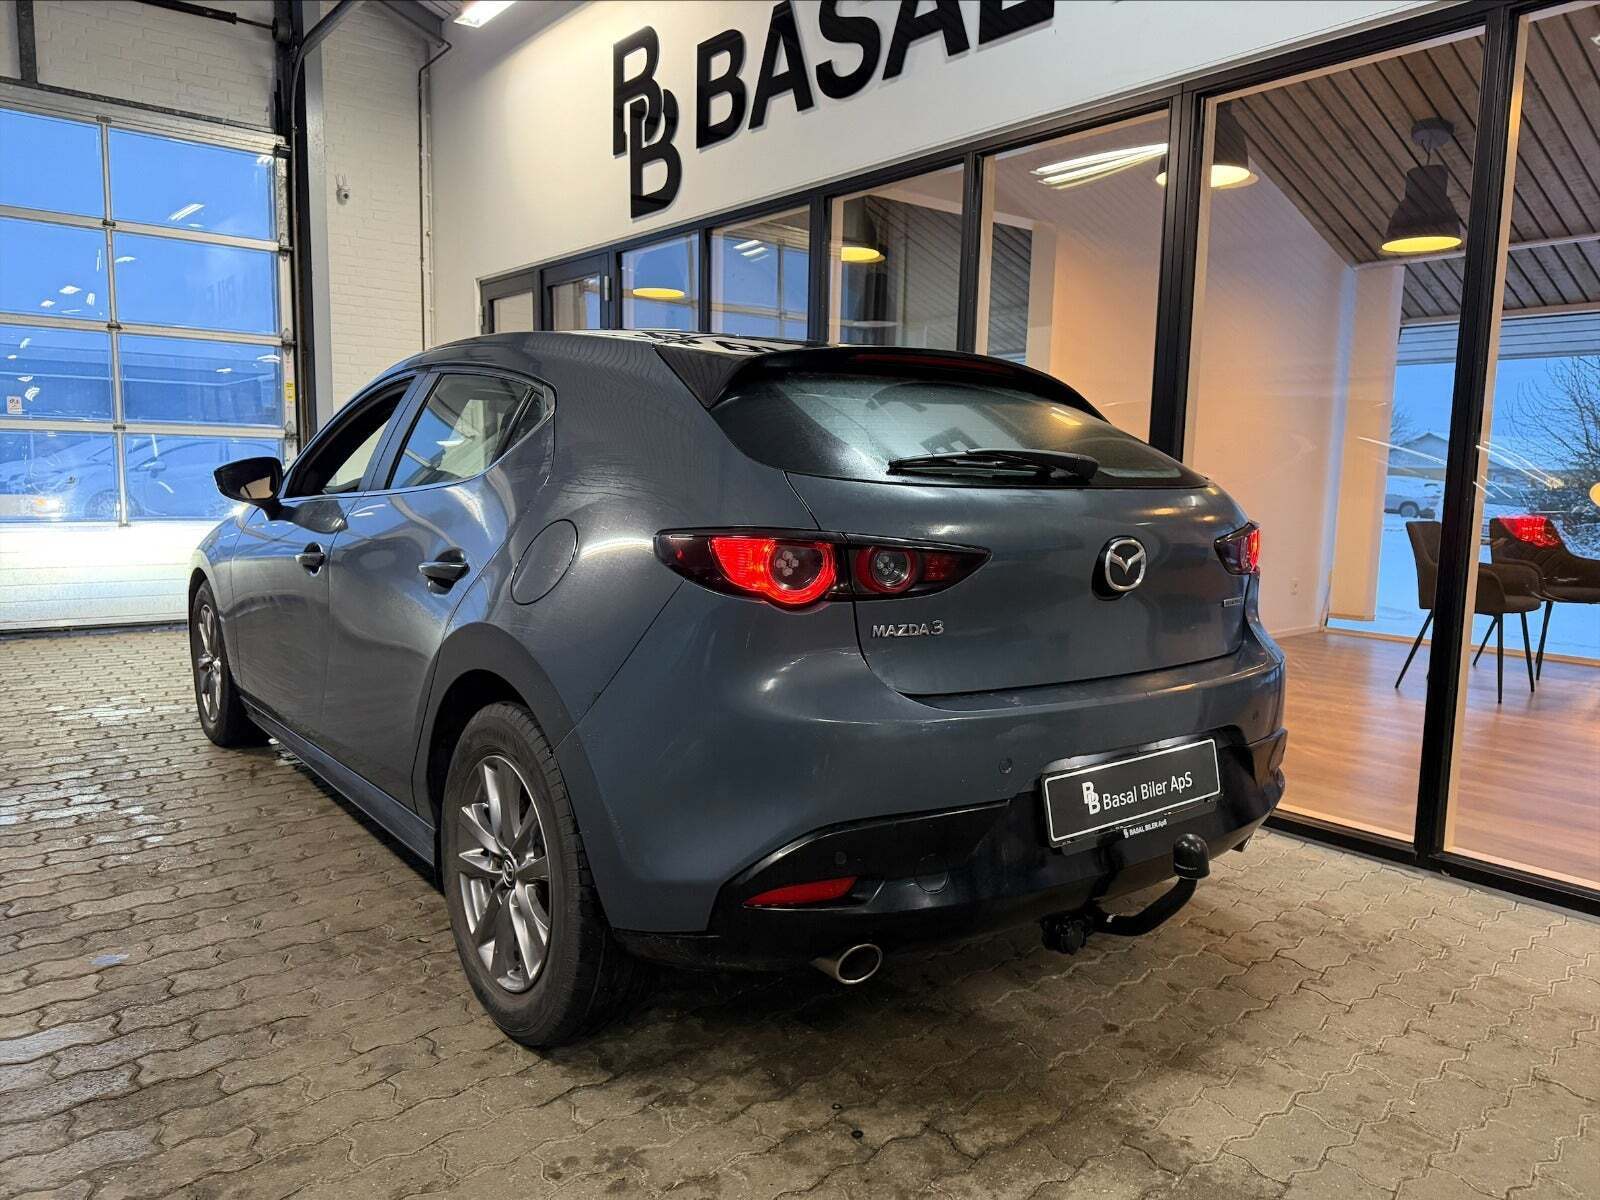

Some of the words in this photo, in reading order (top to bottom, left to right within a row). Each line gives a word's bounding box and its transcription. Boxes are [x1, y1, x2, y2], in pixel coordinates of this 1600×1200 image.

[1102, 786, 1138, 810] Basal
[1140, 781, 1168, 801] Biler
[1170, 771, 1193, 794] ApS
